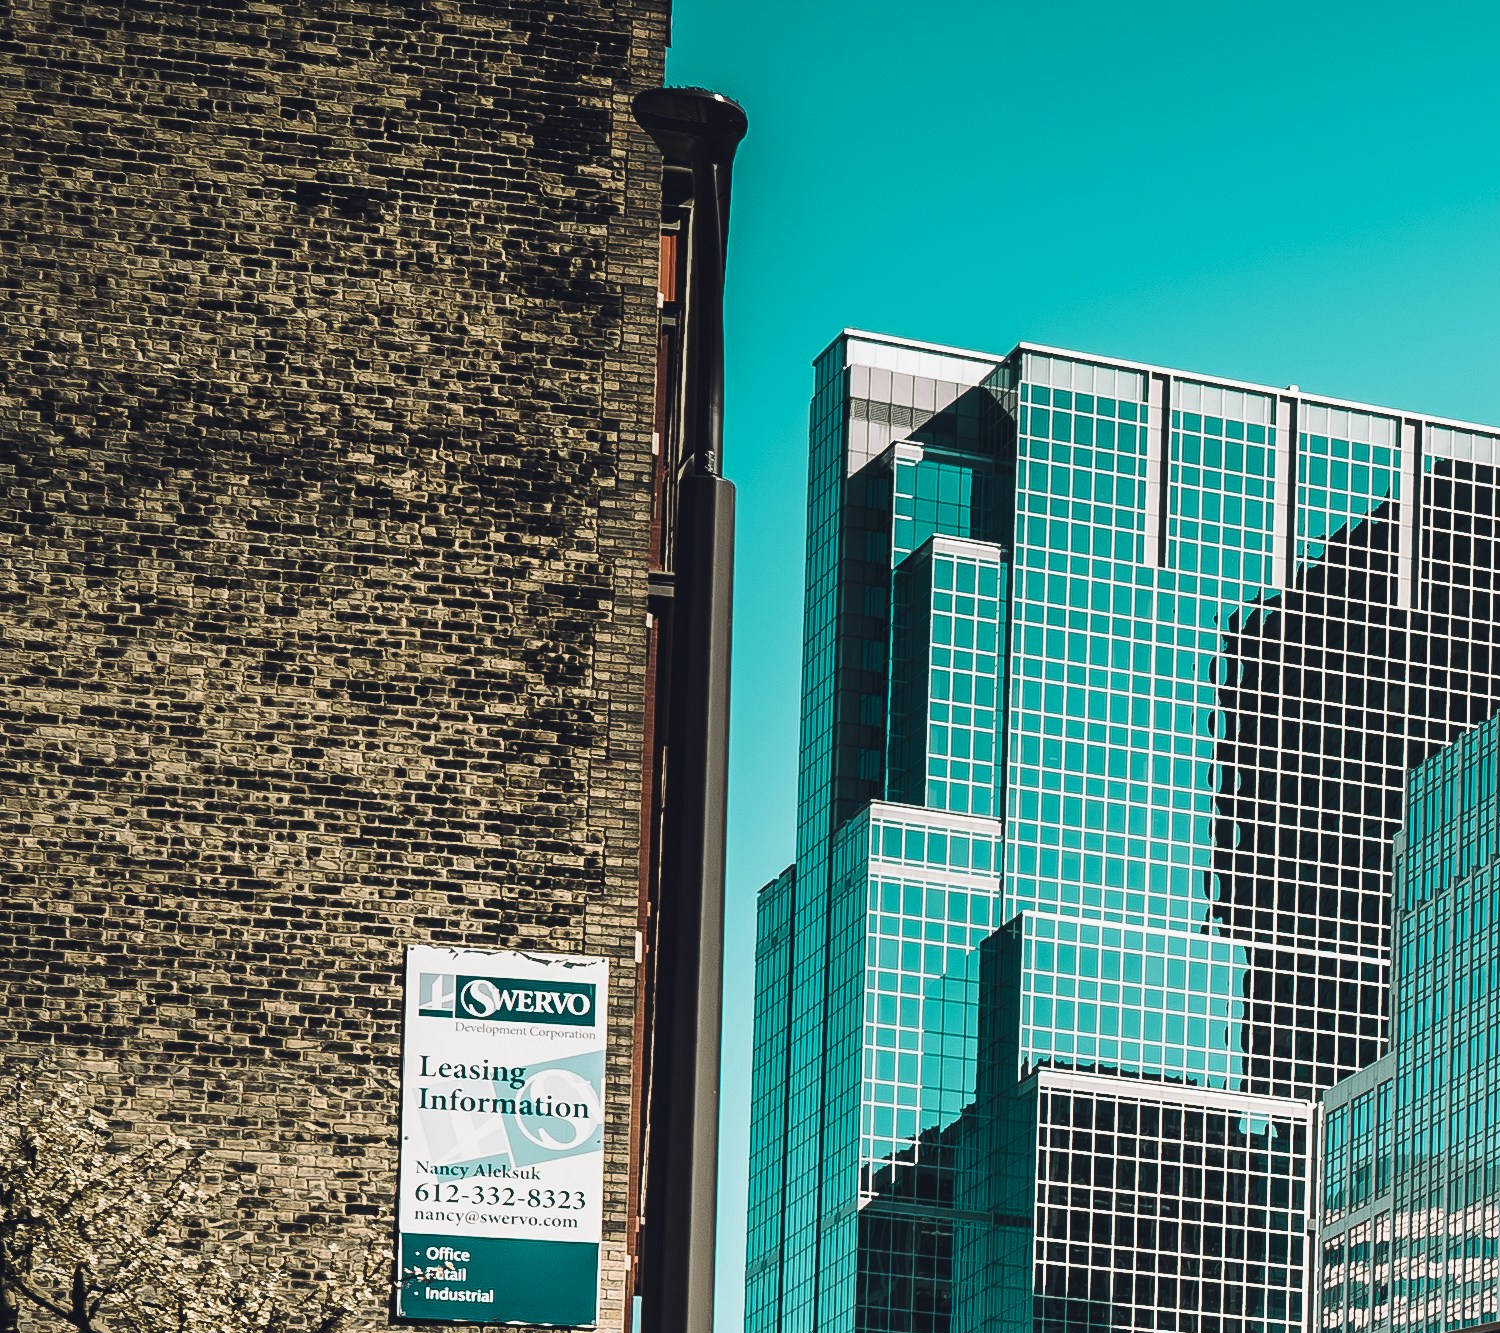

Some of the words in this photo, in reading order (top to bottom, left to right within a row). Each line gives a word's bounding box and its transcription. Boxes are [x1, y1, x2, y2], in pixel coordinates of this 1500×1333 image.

[461, 980, 590, 1017] SWERVO
[455, 1022, 527, 1036] Development
[530, 1026, 596, 1040] Corporation
[419, 1055, 527, 1090] Leasing
[419, 1087, 589, 1119] Information
[416, 1161, 469, 1179] Nancy
[474, 1164, 541, 1181] Aleksuk
[415, 1182, 586, 1210] 612-332-8323
[414, 1209, 578, 1228] nancy@swervo.com
[426, 1247, 470, 1262] Office
[425, 1287, 494, 1303] Industrial
